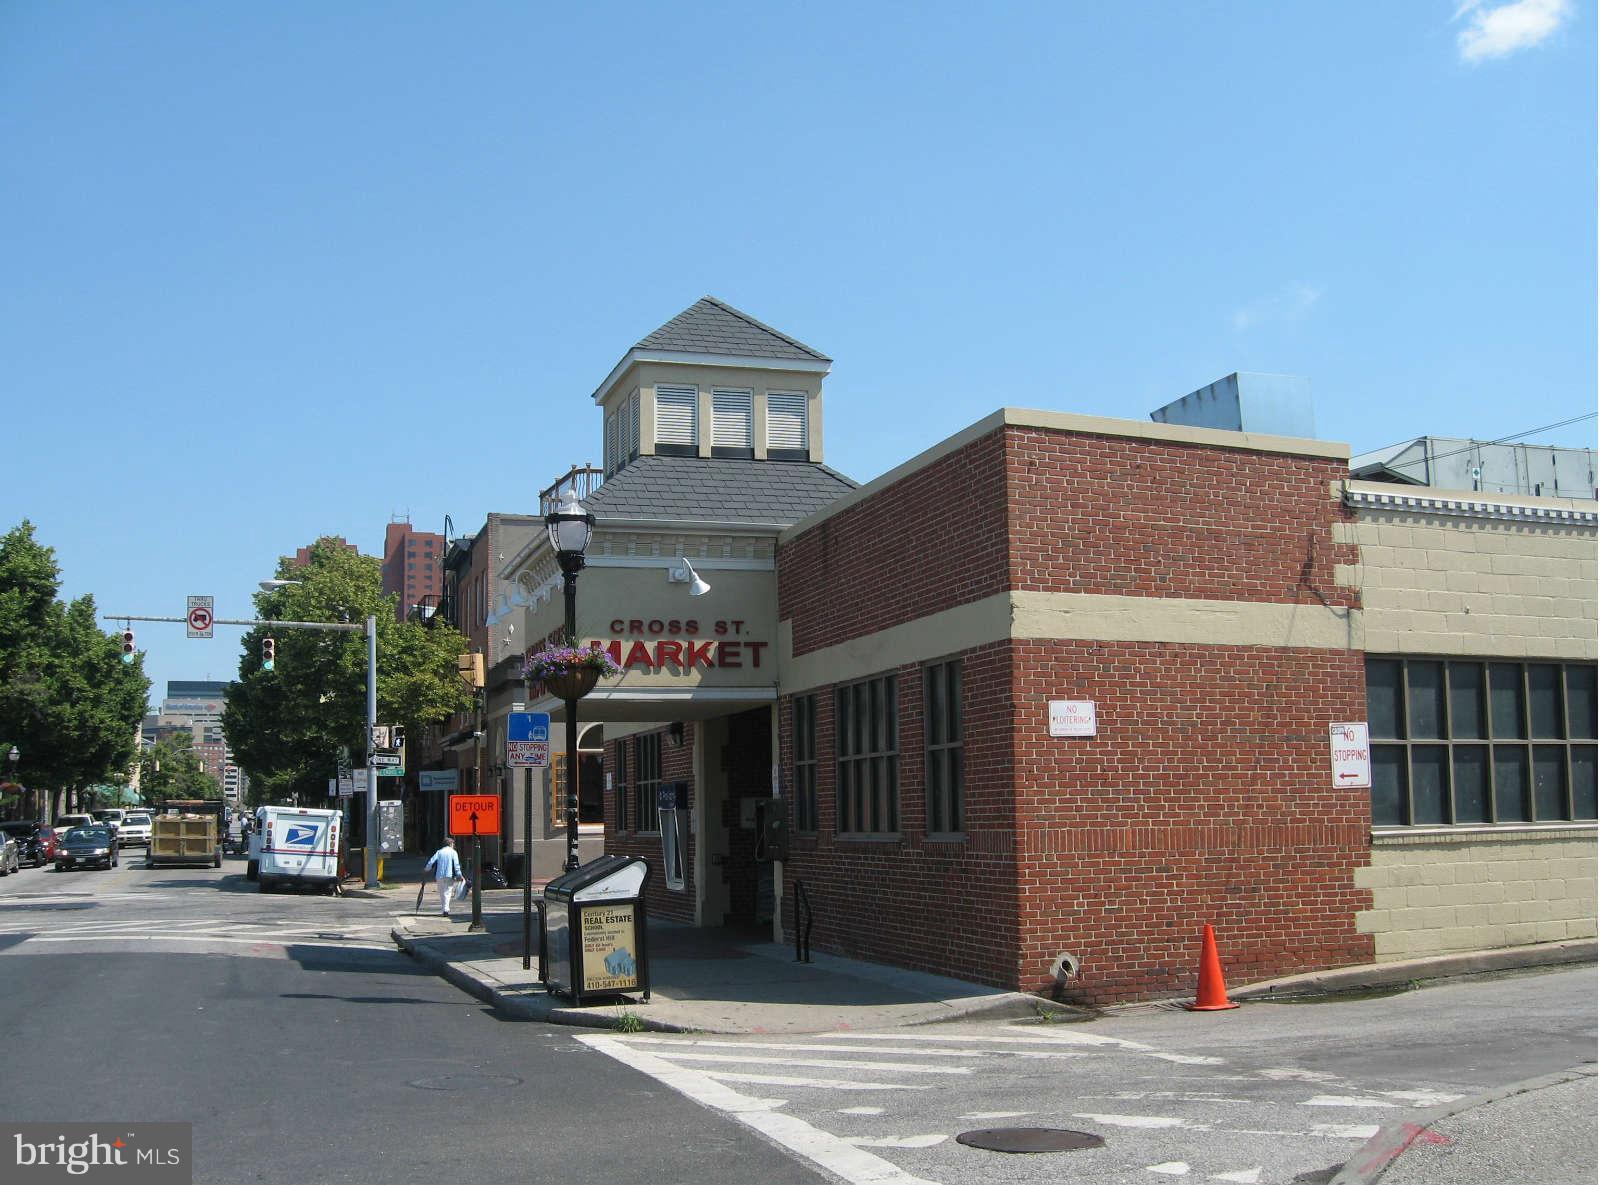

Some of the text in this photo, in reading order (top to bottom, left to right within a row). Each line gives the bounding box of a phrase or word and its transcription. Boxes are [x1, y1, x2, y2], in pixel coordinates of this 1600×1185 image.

[610, 619, 750, 635] CROSS ST.
[590, 640, 768, 668] MARKET
[1065, 704, 1078, 713] NO
[1056, 715, 1088, 724] LOITERING
[1344, 729, 1355, 741] NO
[508, 742, 548, 751] NO STOPPING
[1334, 750, 1367, 761] STOPPING
[455, 801, 495, 811] DETOUR
[584, 911, 605, 919] Century
[584, 915, 633, 925] REAL ESTATE
